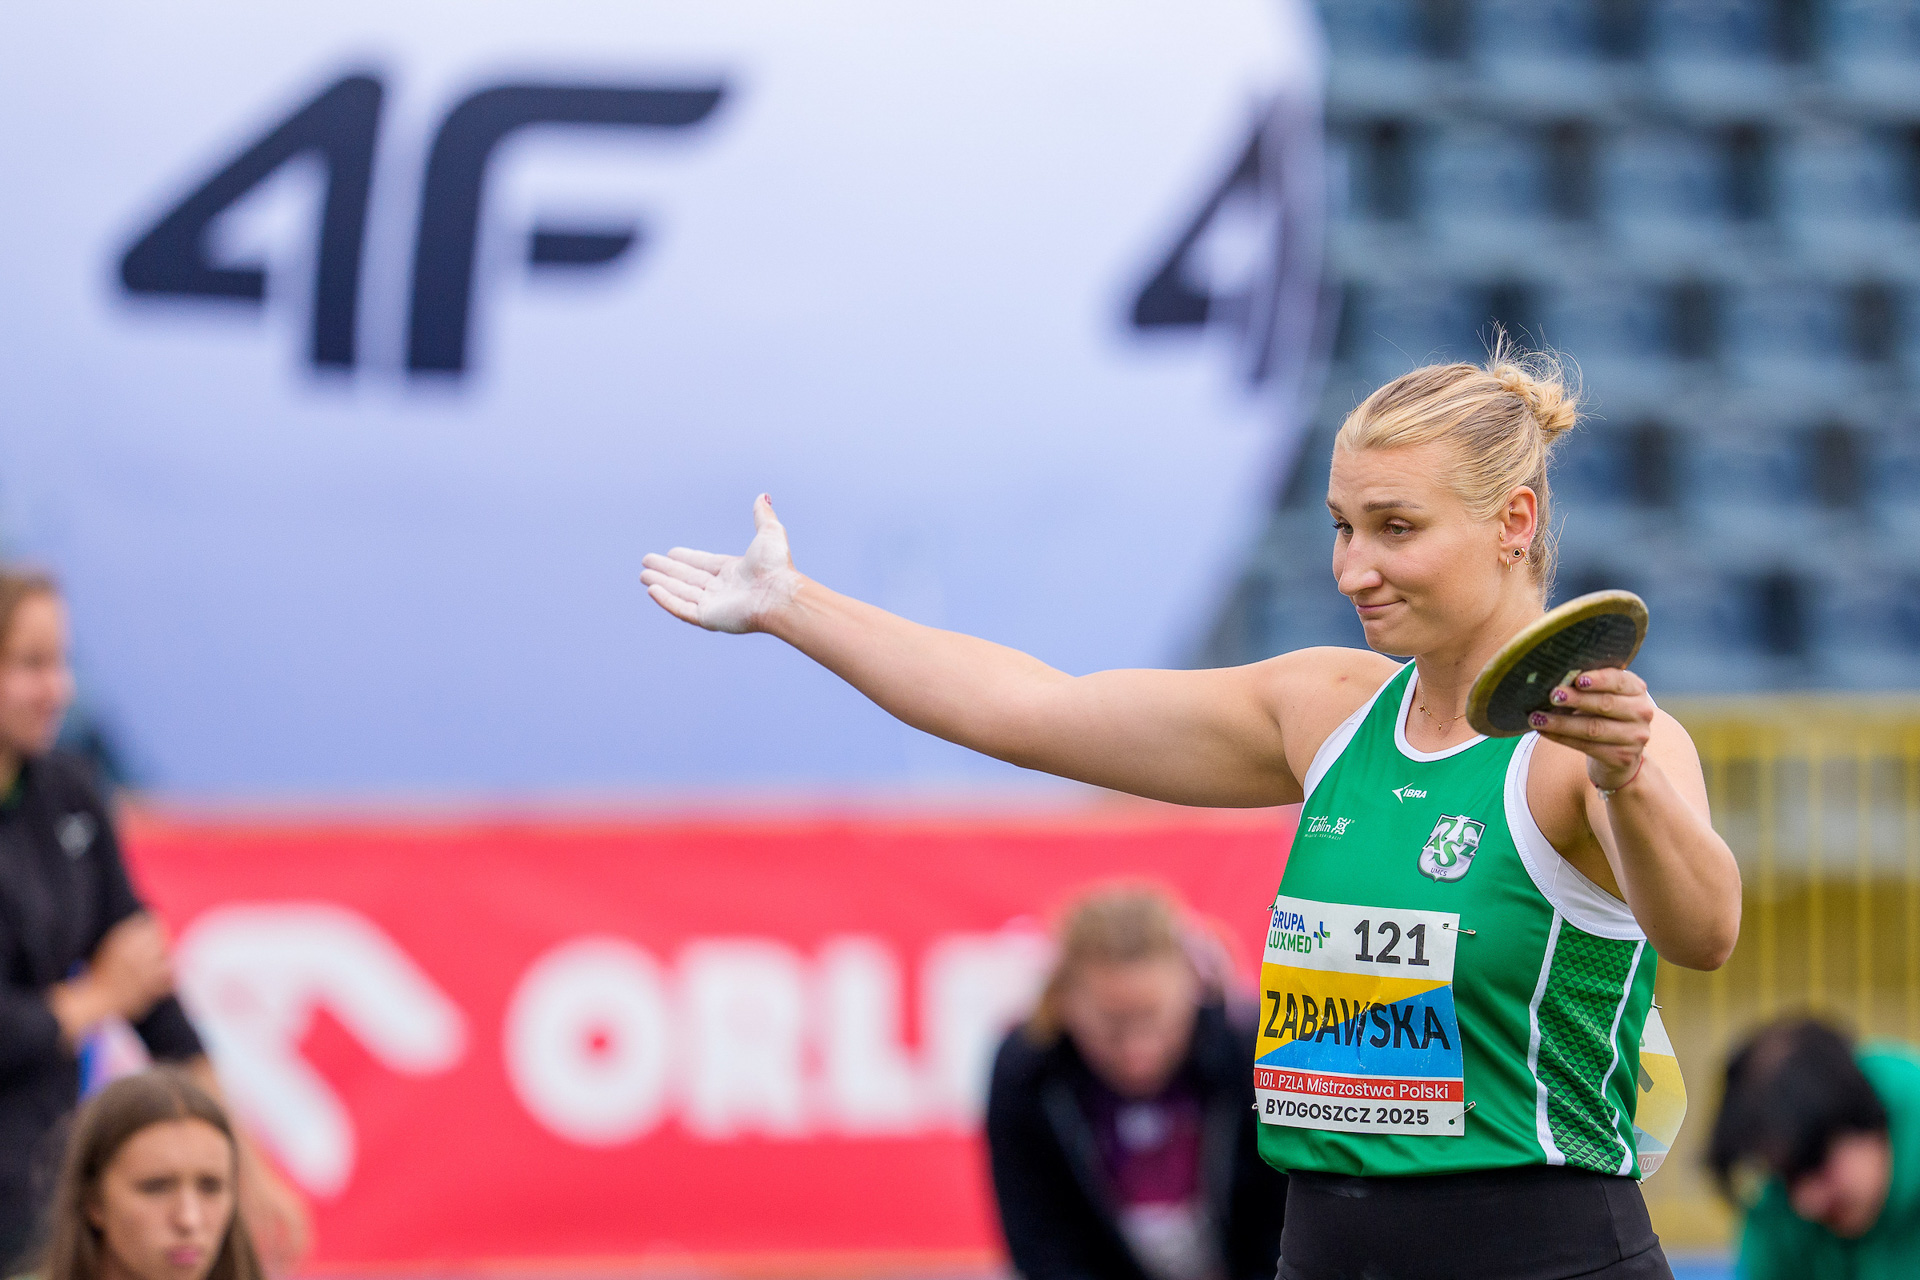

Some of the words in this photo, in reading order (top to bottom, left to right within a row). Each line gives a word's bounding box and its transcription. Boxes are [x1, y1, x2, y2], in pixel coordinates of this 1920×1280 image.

[120, 75, 726, 373] 4F
[1430, 867, 1448, 877] UMCS
[1272, 909, 1306, 933] GRUPA
[1268, 929, 1312, 954] LUXMED
[1353, 919, 1430, 967] 121
[1263, 989, 1452, 1051] ZABAWSKA
[503, 932, 1045, 1150] ORLE
[1259, 1071, 1276, 1089] 101.
[1278, 1074, 1304, 1091] PZLA
[1306, 1077, 1395, 1098] Mistrzostwa
[1399, 1083, 1449, 1099] Polski
[1265, 1098, 1371, 1124] BYDGOSZCZ
[1376, 1107, 1430, 1126] 2025
